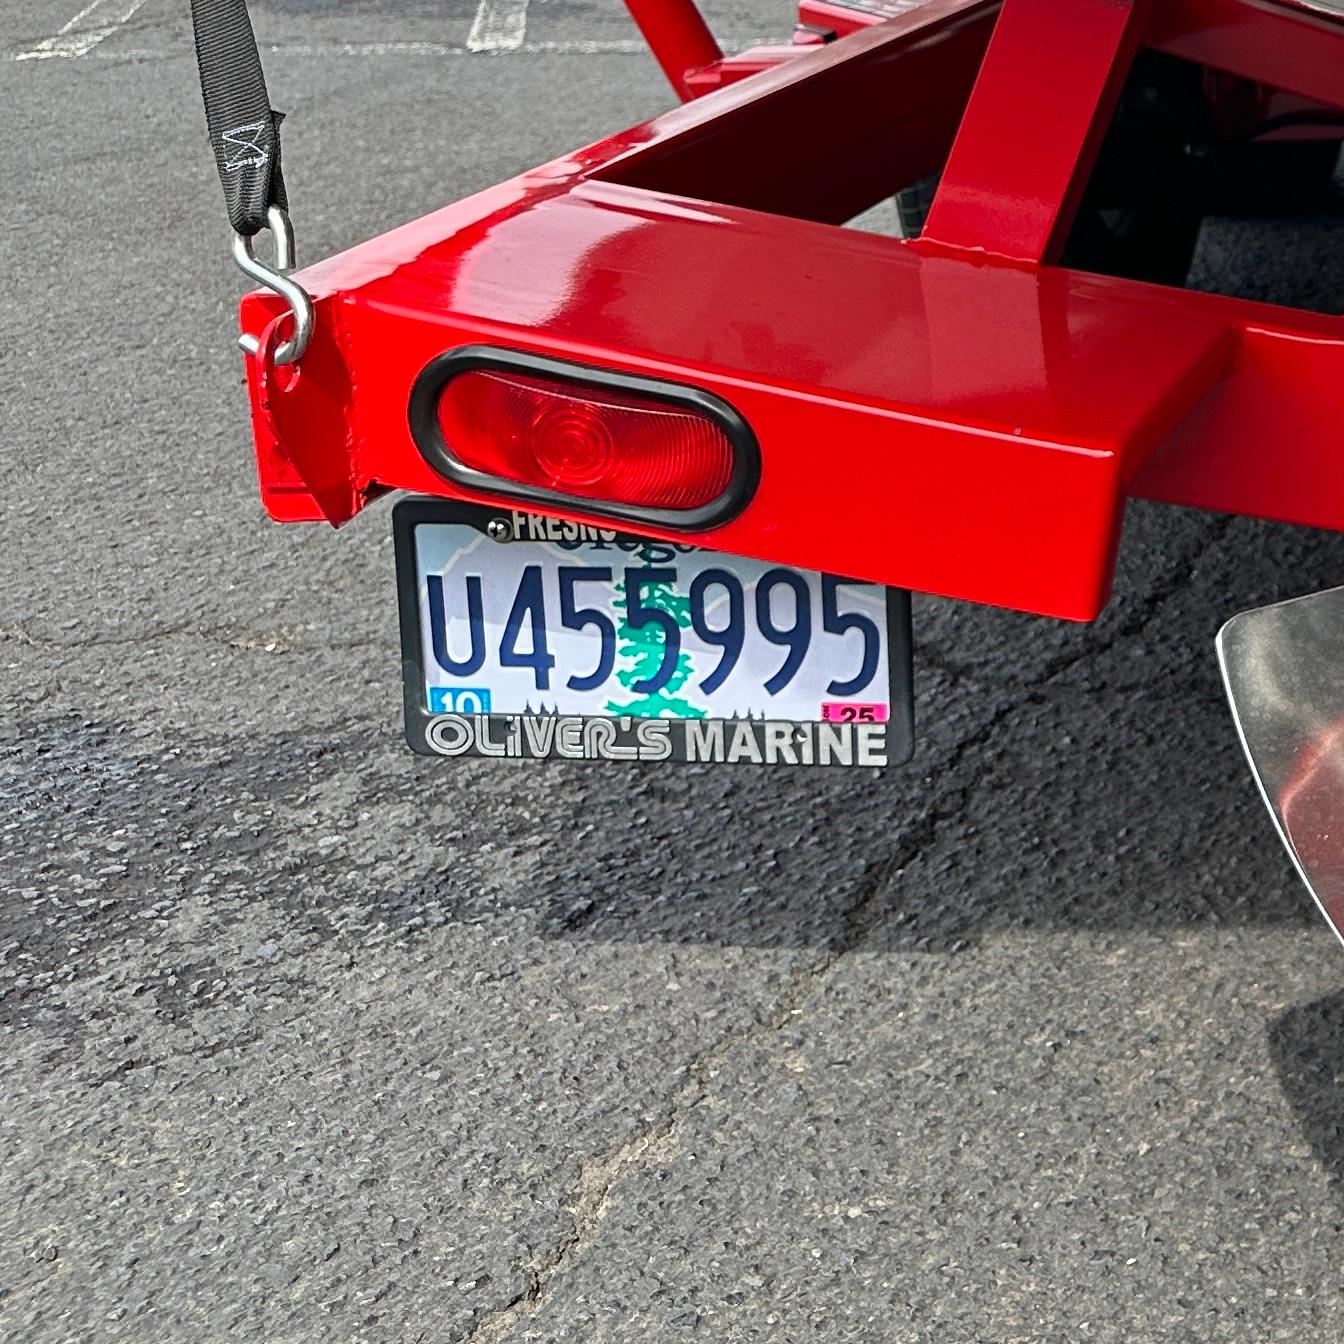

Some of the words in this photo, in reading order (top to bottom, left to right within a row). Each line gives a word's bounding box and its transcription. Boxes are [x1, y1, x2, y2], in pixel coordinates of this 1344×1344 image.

[427, 565, 880, 697] U455995
[440, 691, 482, 713] 10
[840, 707, 875, 722] 25
[425, 714, 673, 761] OLIVER'S
[685, 719, 888, 766] MARINE
